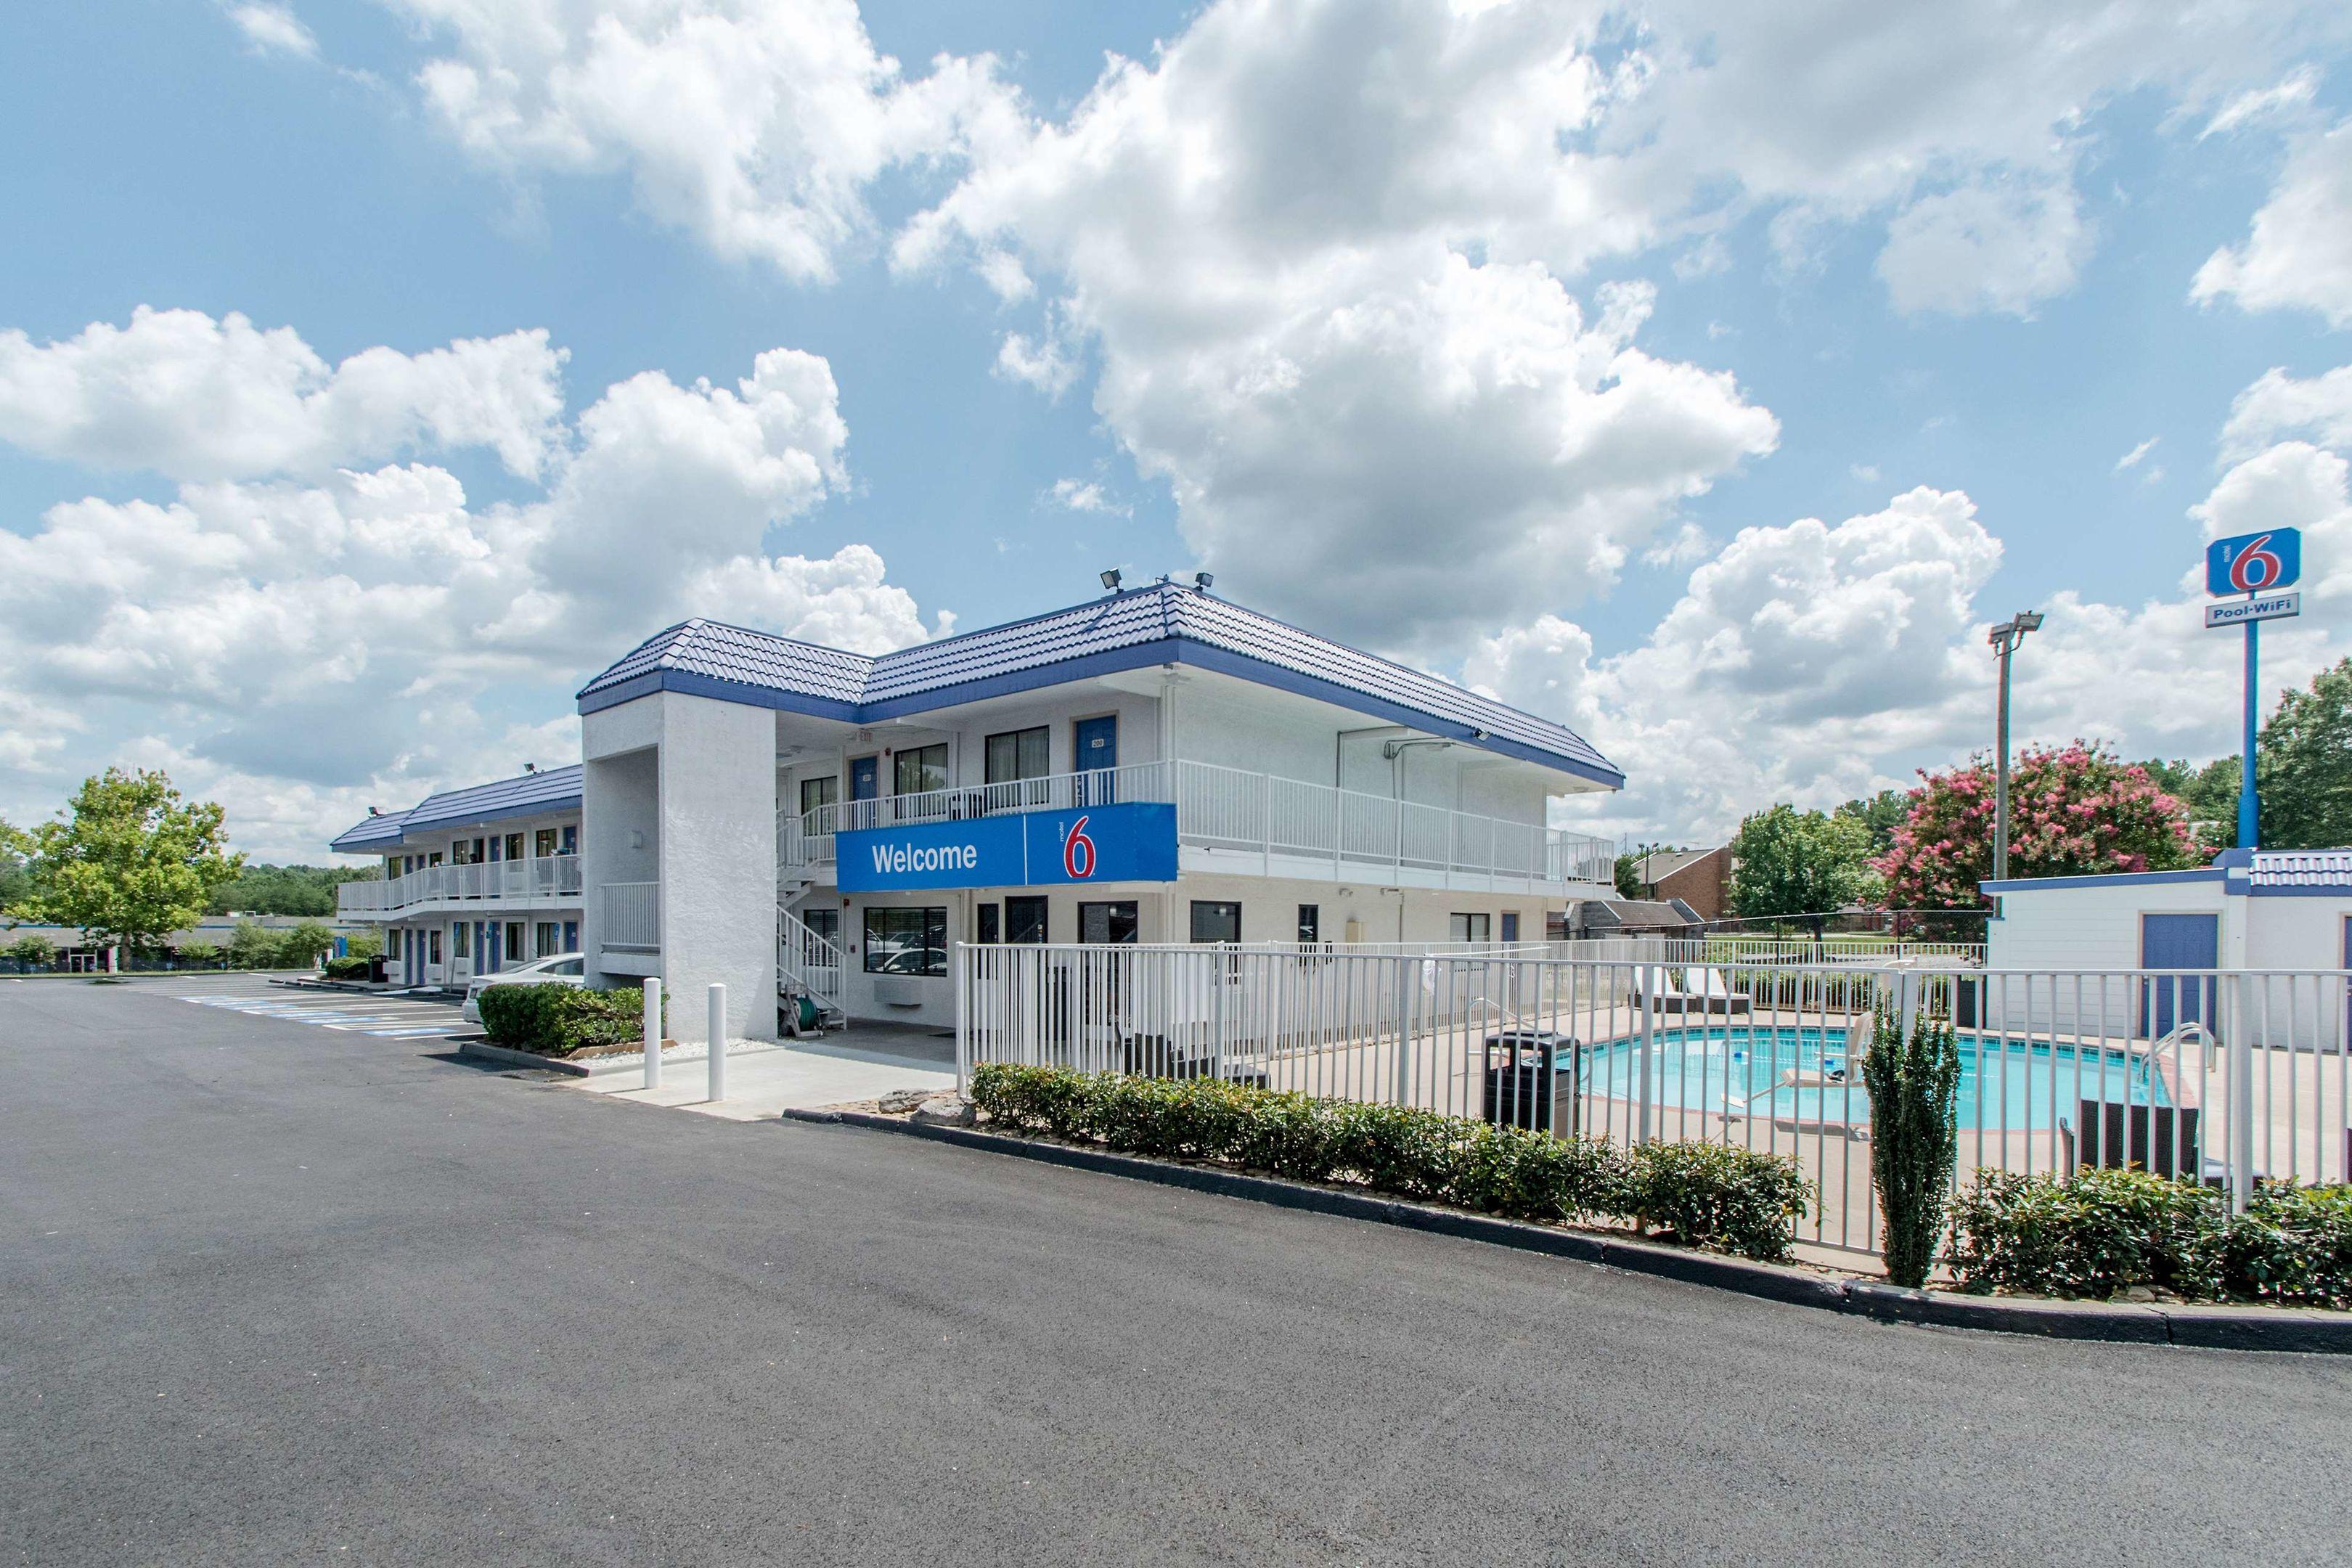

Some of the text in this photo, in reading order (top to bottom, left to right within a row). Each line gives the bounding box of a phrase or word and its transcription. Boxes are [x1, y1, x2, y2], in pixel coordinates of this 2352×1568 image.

[2230, 535, 2282, 589] 6
[872, 843, 977, 873] Welcome
[1063, 815, 1095, 878] 6
